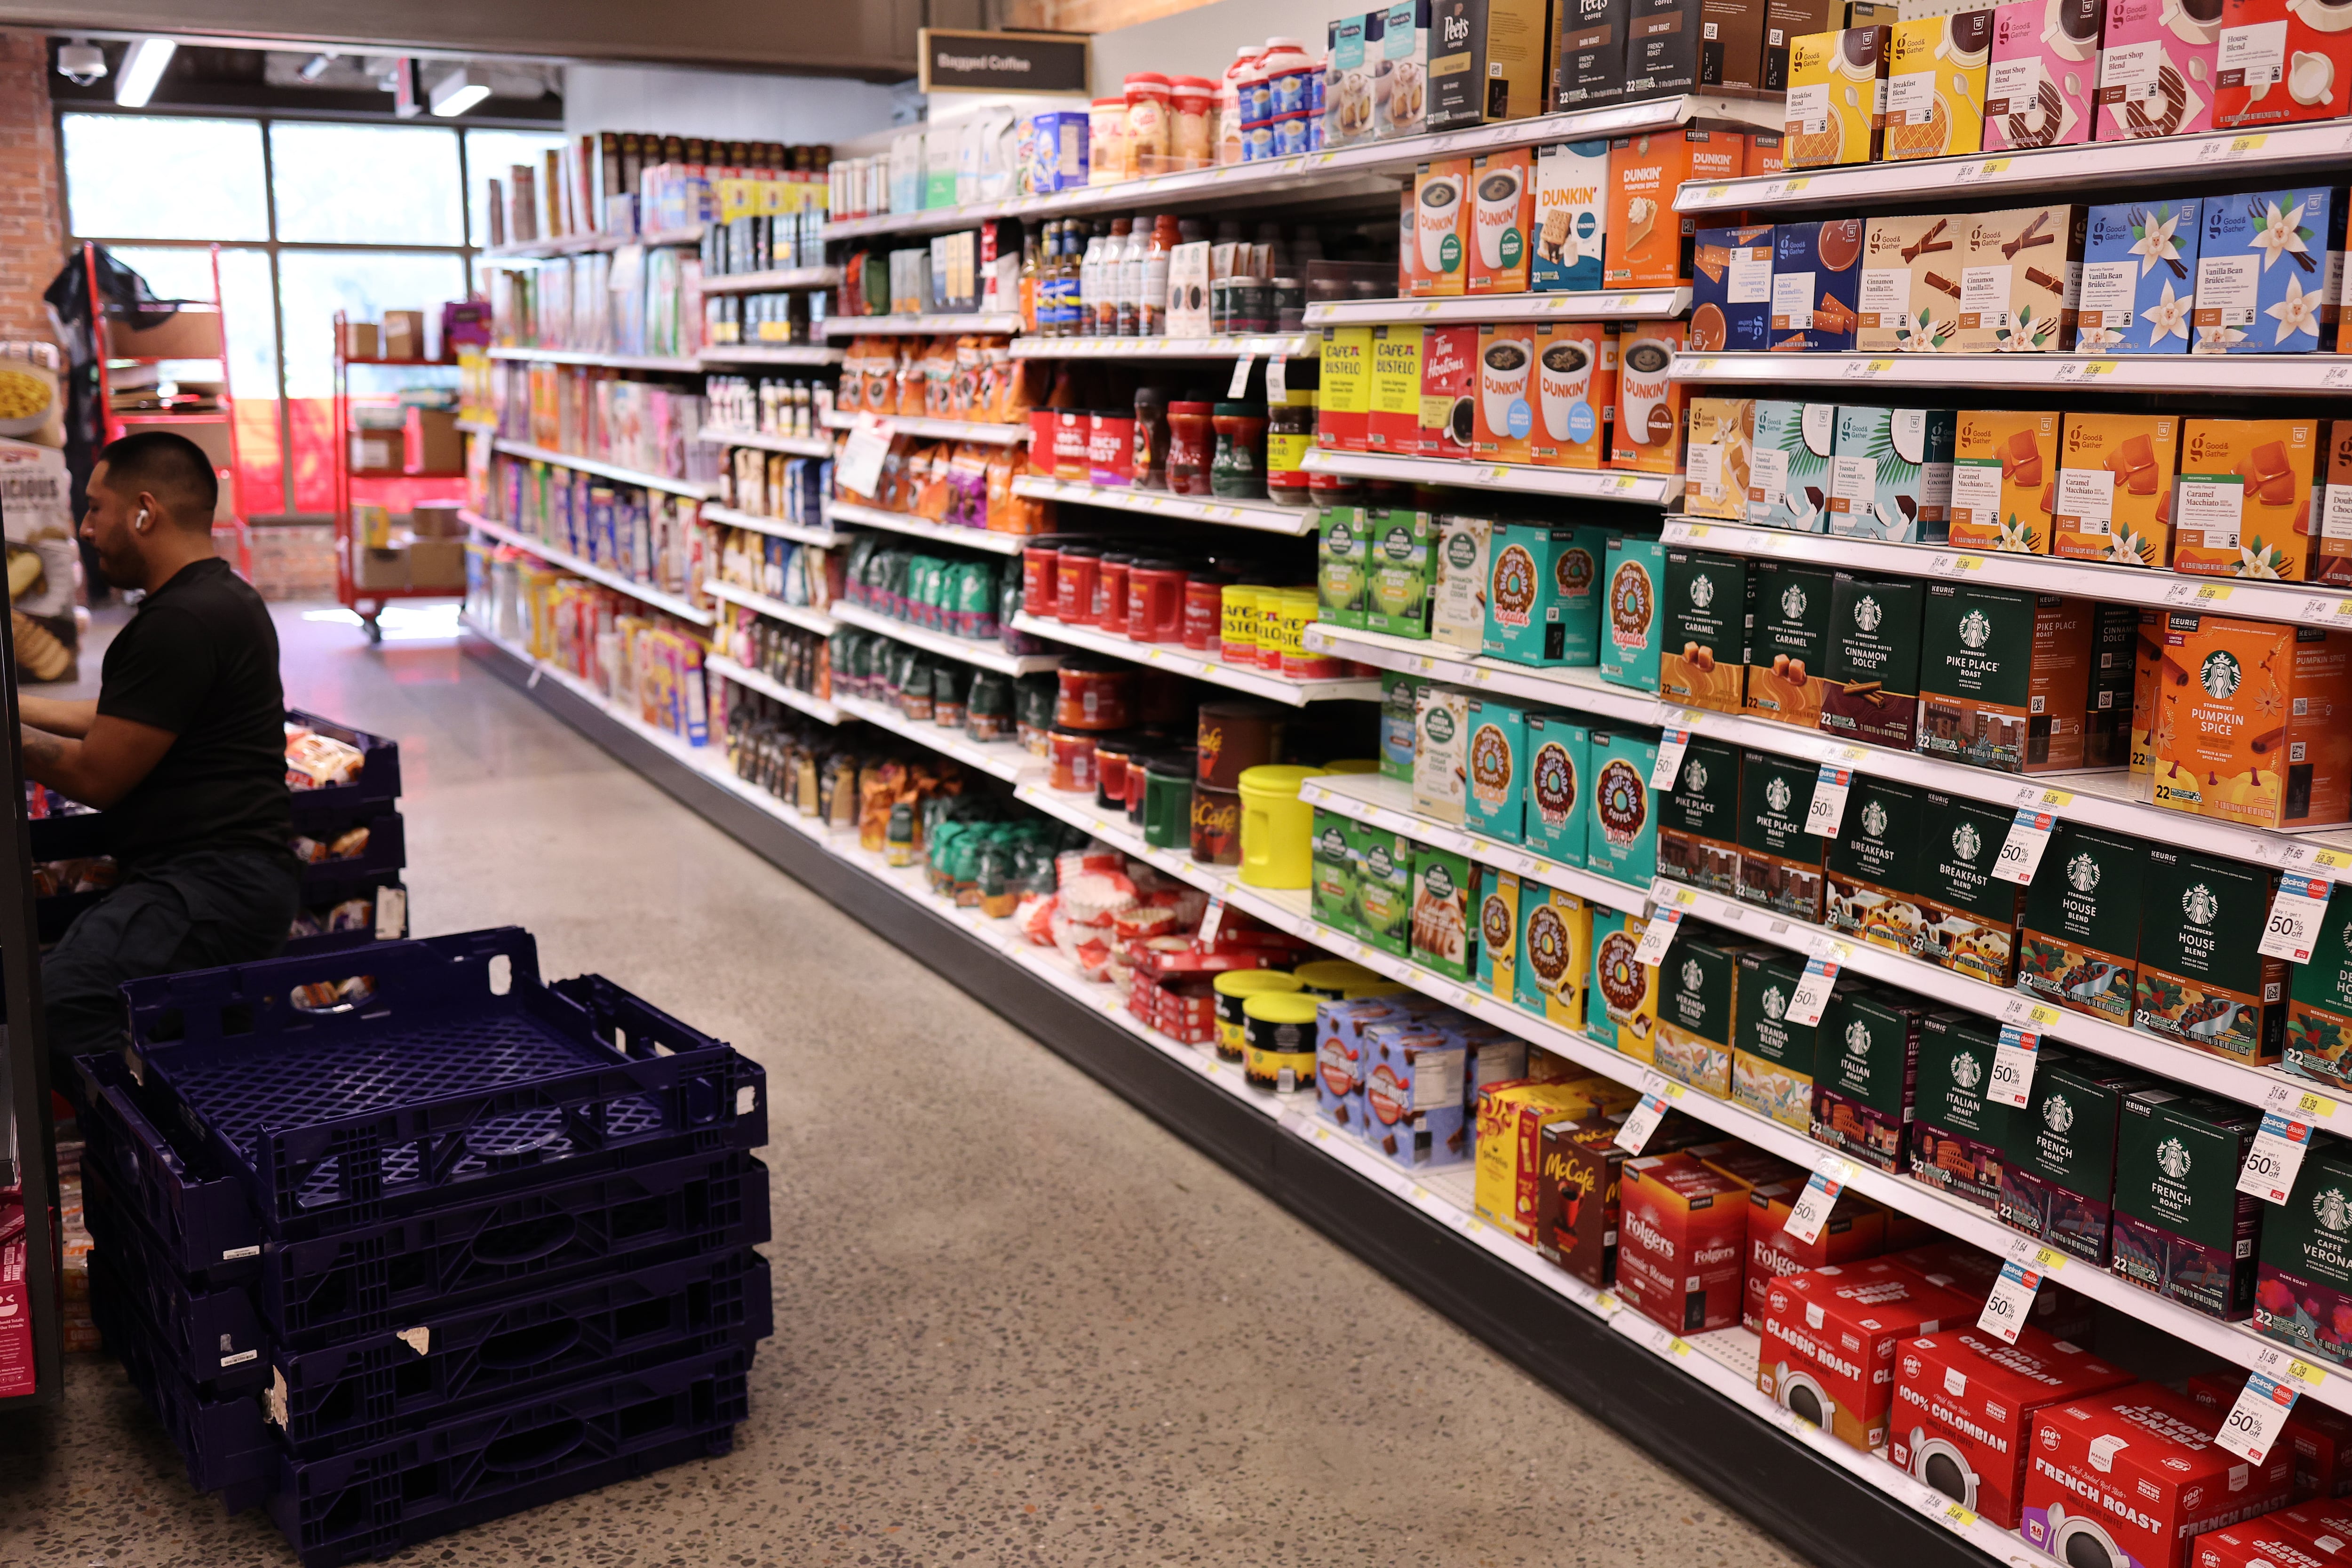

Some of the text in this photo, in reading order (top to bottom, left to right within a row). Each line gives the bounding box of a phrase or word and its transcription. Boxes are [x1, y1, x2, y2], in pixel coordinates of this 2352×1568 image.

[1444, 16, 1469, 41] Peet's
[1649, 23, 1670, 32] DARK ROAST
[2227, 34, 2249, 43] House
[2227, 42, 2245, 51] Blend
[938, 53, 1031, 72] Bagged Coffee
[1627, 80, 1635, 92] 22
[1693, 153, 1731, 165] DUNKIN'
[1623, 167, 1662, 182] DUNKIN'
[1958, 167, 1974, 175] 28.18
[1981, 165, 1996, 174] 10.99
[1542, 187, 1597, 207] DUNKIN'
[2106, 224, 2126, 233] Good&
[2105, 232, 2125, 240] Gather
[1434, 335, 1453, 355] Tim
[1376, 360, 1415, 374] BUSTELO
[1427, 358, 1464, 380] Hortons
[2058, 365, 2076, 375] 31.40
[2084, 364, 2101, 374] 10.99
[1542, 378, 1587, 396] DUNKIN'
[1626, 379, 1669, 397] DUNKIN'
[1648, 421, 1671, 430] HAZELNUT
[2066, 479, 2090, 487] Caramel
[2186, 490, 2214, 499] Caramel
[2186, 498, 2219, 508] Macchiato
[2169, 585, 2186, 596] 31.40
[2197, 587, 2215, 598] 10.99
[2056, 621, 2077, 630] PLACE
[2170, 617, 2198, 627] KEURIG
[1613, 627, 1648, 649] Regular
[1775, 634, 1807, 647] CARAMEL
[1845, 647, 1887, 662] CINNAMON
[1852, 658, 1877, 669] DOLCE
[1946, 656, 1999, 672] PIKE PLACE
[1961, 669, 1981, 678] ROAST
[2191, 708, 2244, 726] PUMPKIN
[2201, 722, 2232, 736] SPICE
[1918, 735, 1929, 748] 22
[2017, 788, 2034, 799] 36.78
[2156, 785, 2169, 799] 22
[2042, 794, 2058, 804] 18.39
[2021, 813, 2050, 825] circle deals
[1605, 826, 1635, 849] DARK
[2151, 851, 2177, 862] KEURIG
[2284, 847, 2304, 859] 31.65
[2315, 854, 2334, 865] 18.39
[1939, 864, 1987, 886] BREAKFAST
[1953, 879, 1971, 890] BLEND
[2289, 877, 2326, 892] circle deals
[2067, 891, 2095, 902] STARBUCKS
[2063, 899, 2097, 917] HOUSE
[2067, 912, 2089, 923] BLEND
[2292, 930, 2302, 939] off
[2178, 932, 2215, 951] HOUSE
[2185, 947, 2207, 957] BLEND
[2157, 971, 2172, 980] MEDIUM
[2137, 1009, 2150, 1025] 22
[1756, 1022, 1788, 1042] VERANDA
[1760, 1034, 1783, 1048] BLEND
[2270, 1086, 2288, 1101] 31.64
[1946, 1092, 1980, 1112] ITALIAN
[2299, 1096, 2317, 1110] 18.39
[1952, 1106, 1972, 1117] ROAST
[2036, 1135, 2073, 1159] FRENCH
[2044, 1150, 2064, 1163] ROAST
[1544, 1152, 1595, 1193] McCafé
[2152, 1183, 2191, 1206] FRENCH
[2160, 1197, 2182, 1211] ROAST
[1625, 1210, 1674, 1258] Folgers
[2145, 1224, 2158, 1234] ROAST
[2317, 1239, 2342, 1253] CAFFÈ
[1693, 1246, 1735, 1266] Folgers
[2303, 1243, 2352, 1270] VERONA
[1621, 1246, 1674, 1289] Classic Roast
[1766, 1317, 1862, 1381] CLASSIC ROAST
[2259, 1349, 2278, 1364] 31.98
[1899, 1384, 2007, 1454] 100% COLOMBIAN
[2040, 1429, 2061, 1440] 100%
[2091, 1451, 2110, 1464] MARKET
[2035, 1457, 2162, 1535] FRENCH ROAST
[2066, 1494, 2122, 1529] SINGLE SERVE COFFEE
